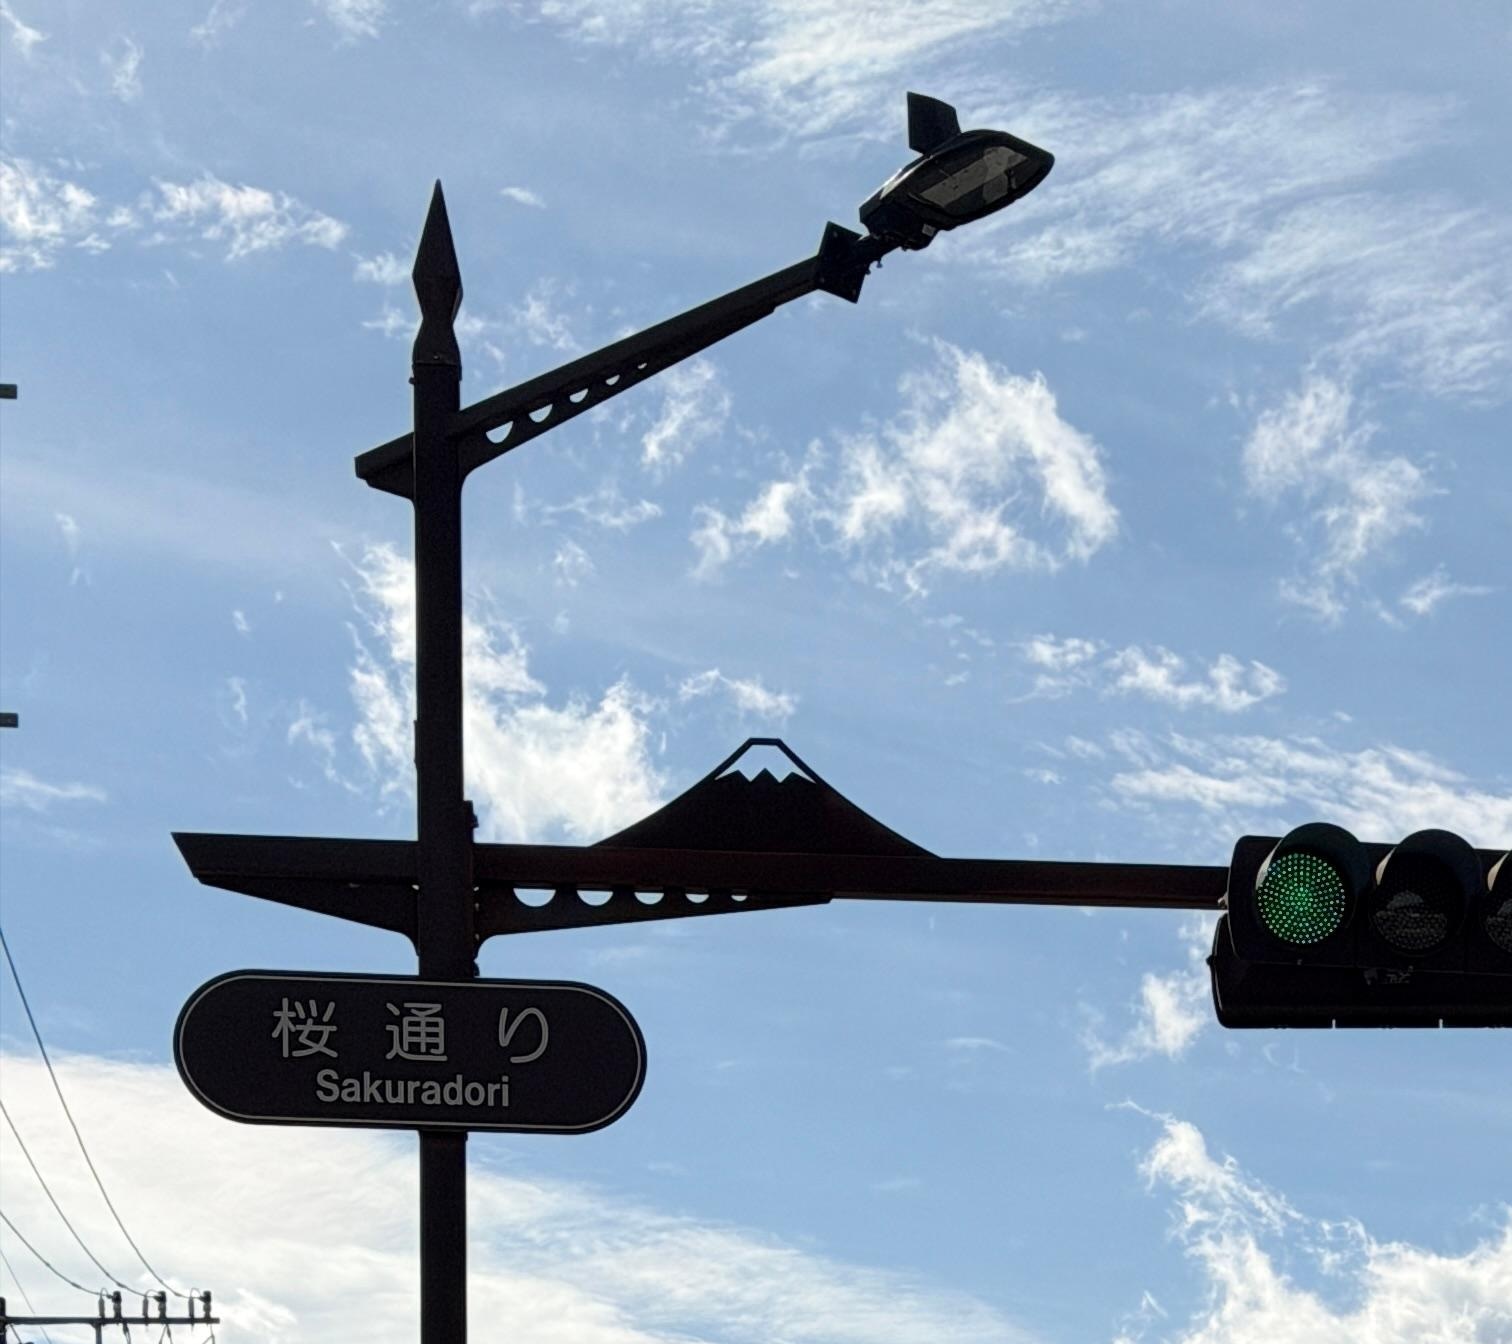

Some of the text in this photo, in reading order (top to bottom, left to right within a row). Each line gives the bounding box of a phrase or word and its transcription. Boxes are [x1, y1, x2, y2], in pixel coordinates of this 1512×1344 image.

[271, 997, 550, 1064] 桜通り
[315, 1068, 510, 1107] Sakuradori
